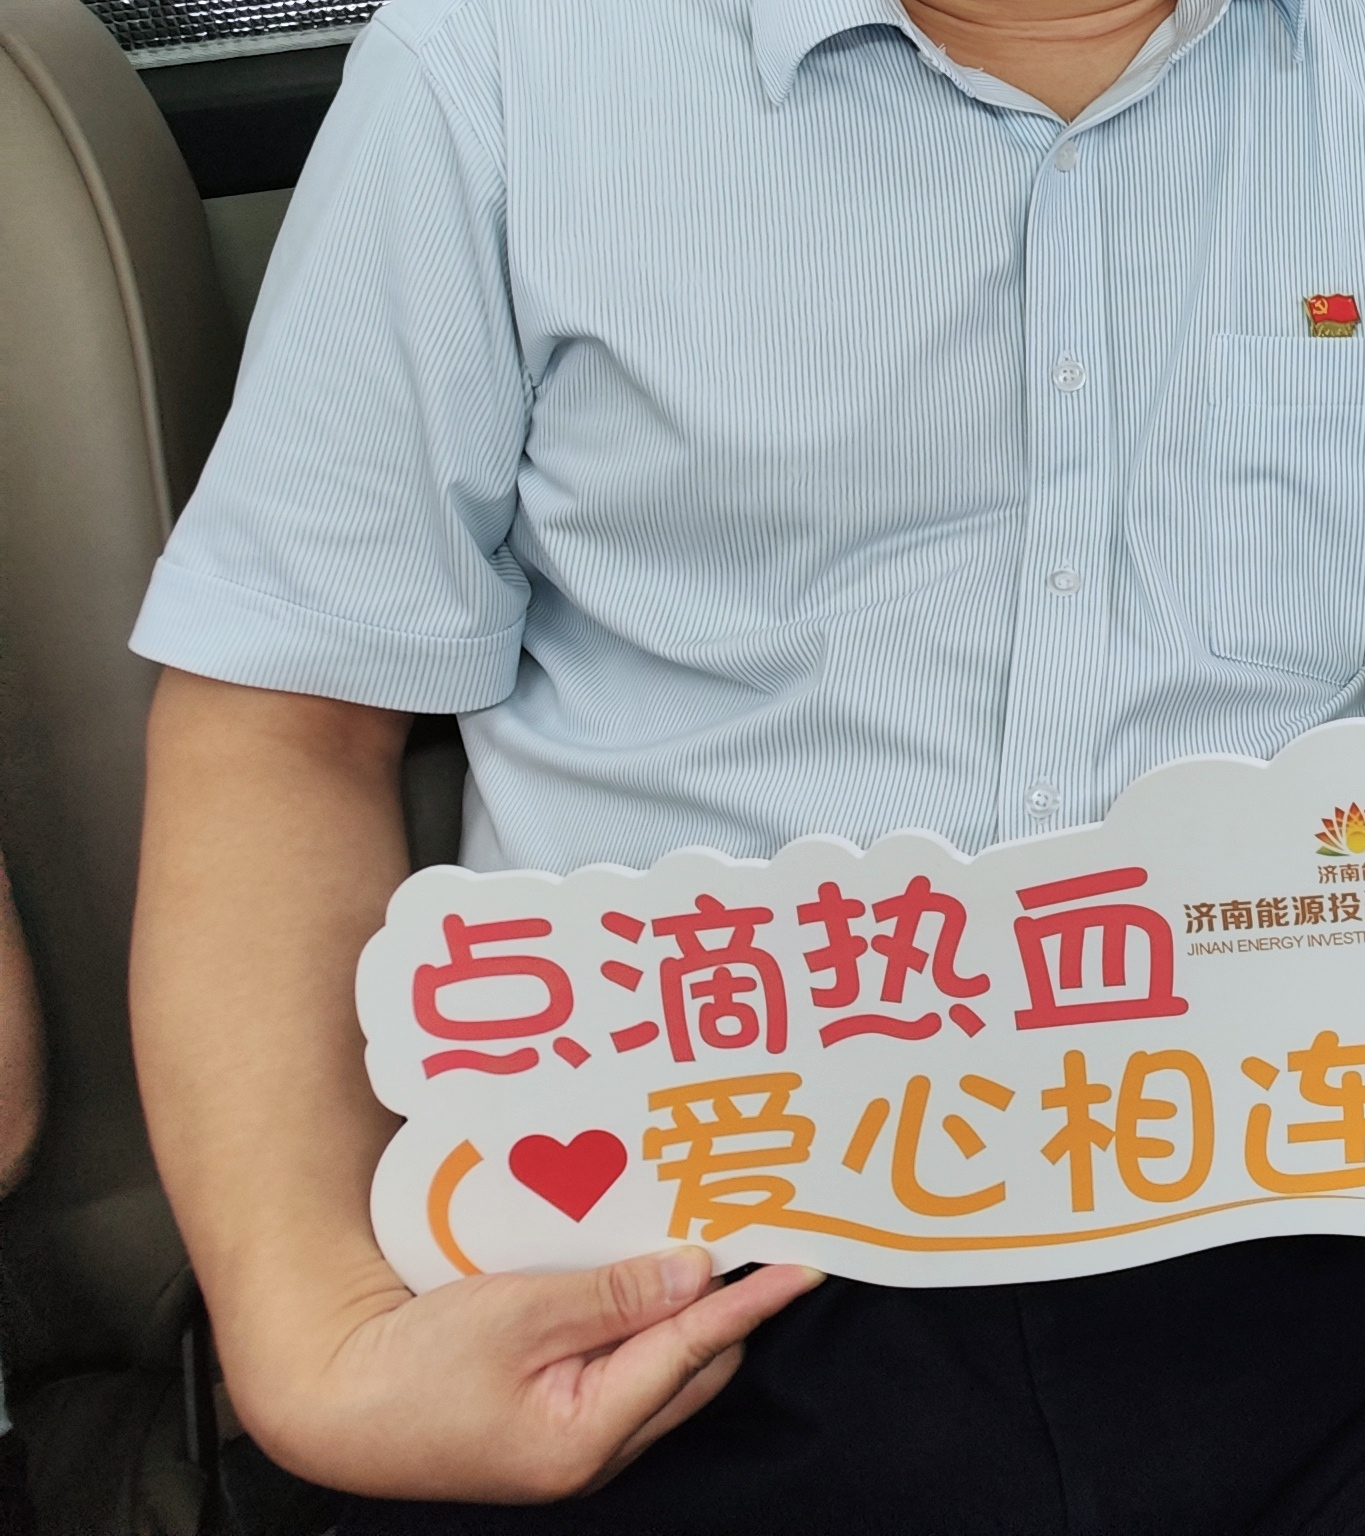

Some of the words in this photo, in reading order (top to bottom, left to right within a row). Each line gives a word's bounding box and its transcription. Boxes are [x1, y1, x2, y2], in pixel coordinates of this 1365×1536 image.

[409, 866, 1189, 1081] 点滴热血
[1186, 940, 1234, 957] JINAN
[1237, 935, 1304, 953] ENERGY
